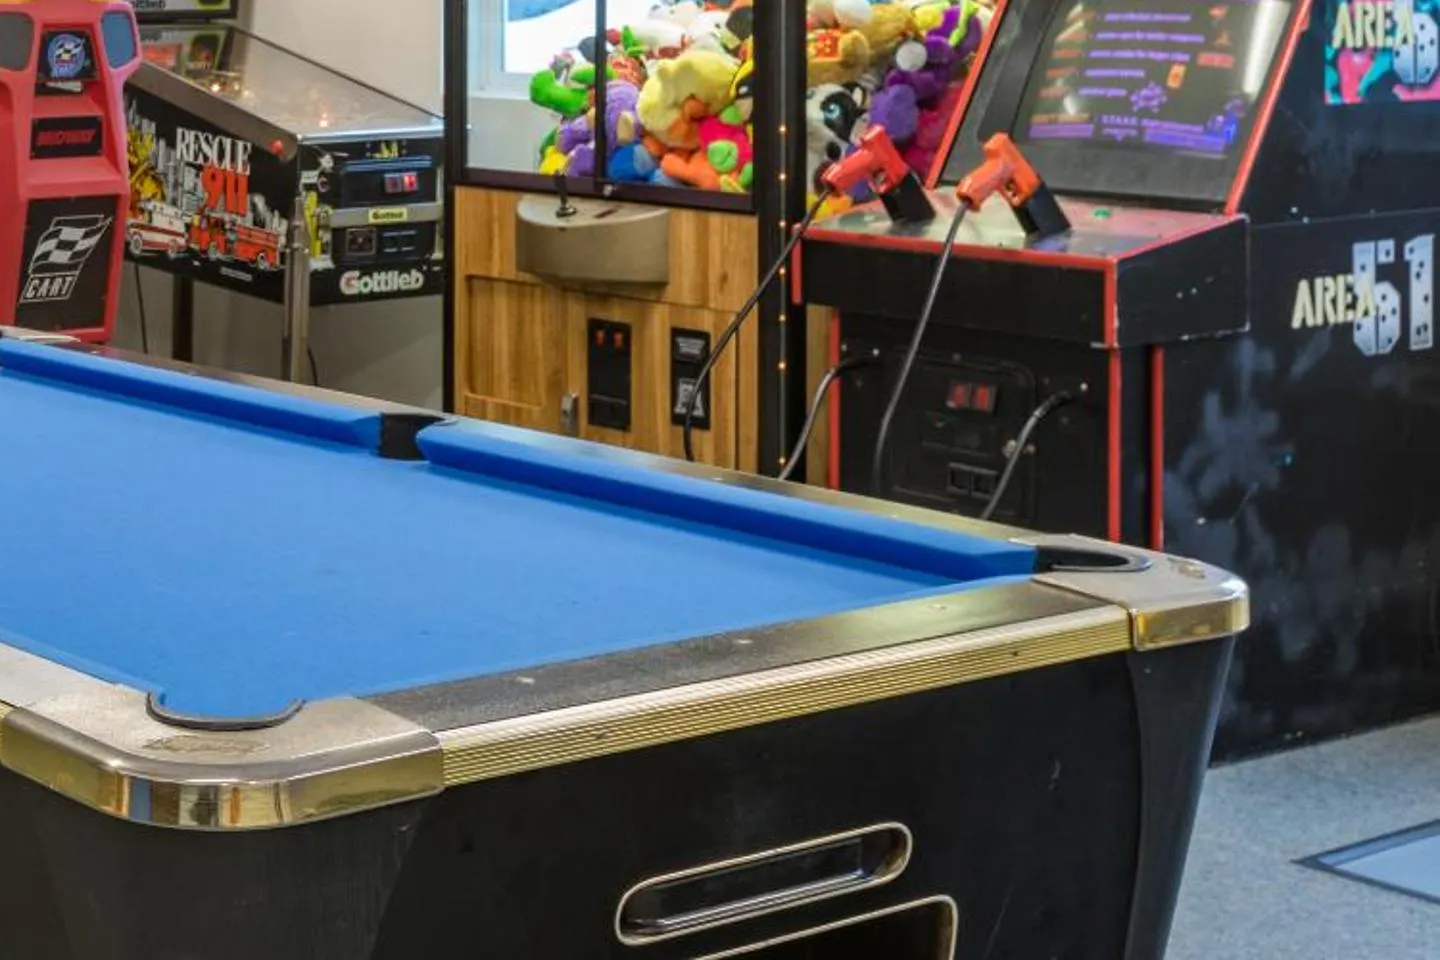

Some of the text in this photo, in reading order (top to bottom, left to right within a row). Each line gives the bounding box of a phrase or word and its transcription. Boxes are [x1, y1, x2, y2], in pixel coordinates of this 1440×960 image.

[1331, 0, 1415, 49] AREA
[175, 126, 253, 176] RESCUE
[200, 162, 250, 217] 911
[25, 275, 75, 299] CART
[339, 268, 425, 296] Gottlieb
[1291, 233, 1436, 357] AREA 51
